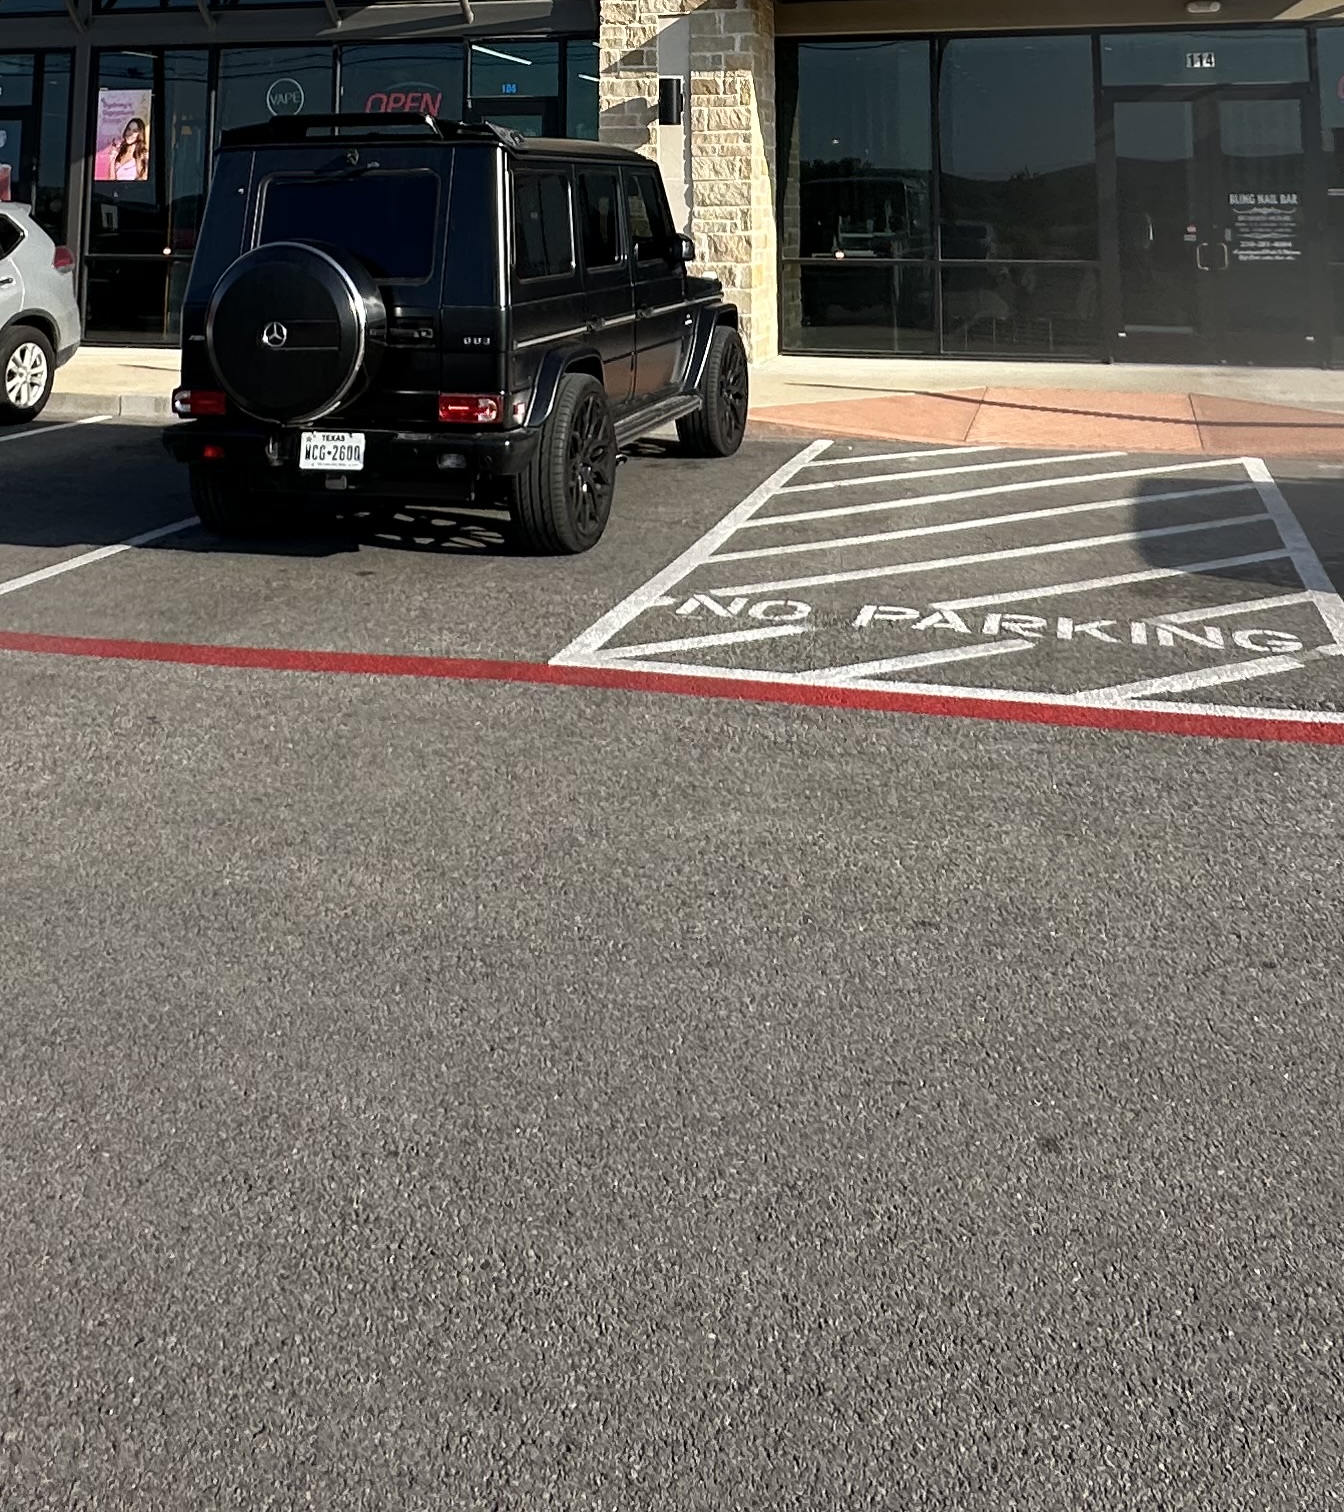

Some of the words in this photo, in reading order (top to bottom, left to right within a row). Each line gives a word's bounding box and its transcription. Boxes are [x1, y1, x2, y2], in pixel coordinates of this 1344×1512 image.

[1187, 53, 1215, 68] 114
[269, 91, 301, 105] VAPE
[365, 92, 442, 117] OPEN
[322, 434, 346, 442] TEXAS
[674, 592, 814, 622] NO
[853, 604, 1306, 655] PARKING
